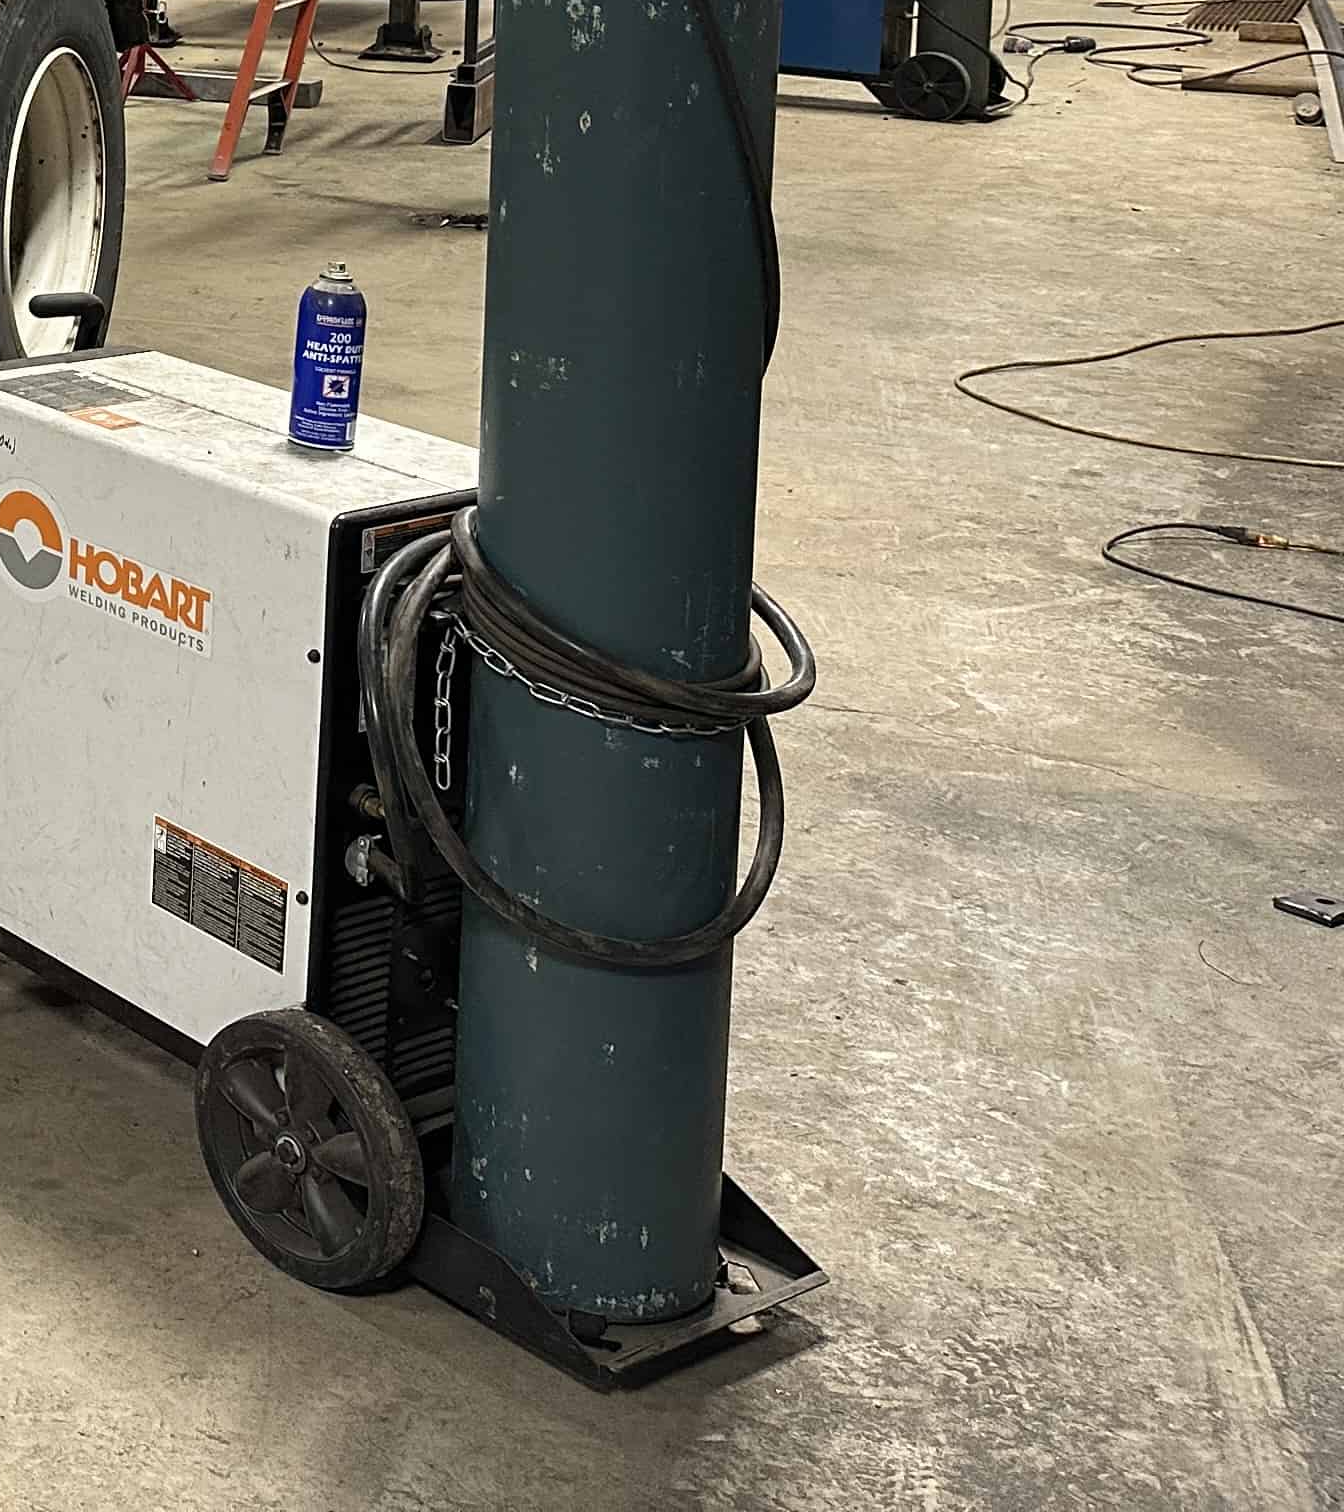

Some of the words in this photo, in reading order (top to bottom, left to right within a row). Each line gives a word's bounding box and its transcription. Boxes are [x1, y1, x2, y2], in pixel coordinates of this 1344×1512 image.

[306, 339, 344, 354] HEAVY
[345, 345, 363, 354] DUT
[329, 332, 352, 345] 200
[68, 537, 211, 633] HOBART
[68, 583, 126, 619] WELDING
[131, 611, 205, 653] PRODUCTS
